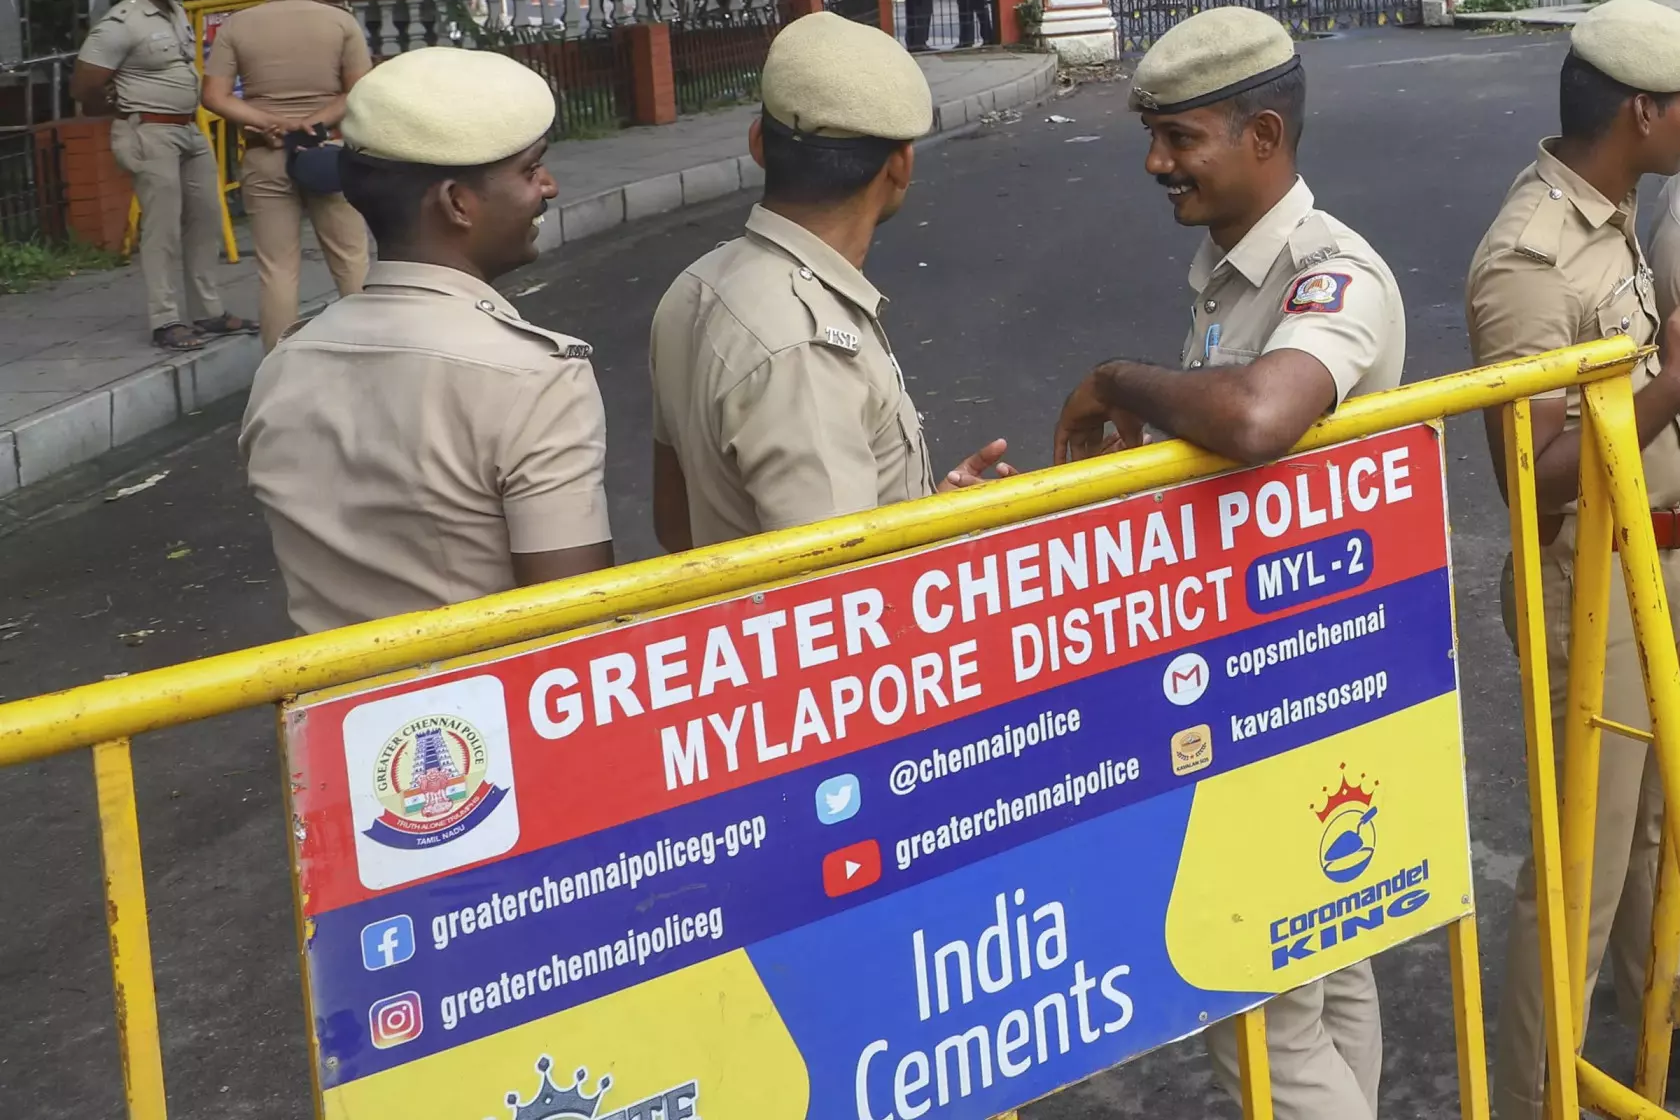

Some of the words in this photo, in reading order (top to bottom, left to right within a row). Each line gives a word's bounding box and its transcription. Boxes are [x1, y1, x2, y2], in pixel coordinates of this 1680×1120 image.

[825, 326, 859, 351] TSP
[527, 586, 891, 741] GREATER
[911, 502, 1199, 635] CHENNAI
[1217, 446, 1413, 548] POLICE
[659, 640, 982, 792] MYLAPORE
[1011, 566, 1233, 683] DISTRICT
[1256, 559, 1325, 601] MYL
[1347, 537, 1365, 574] 2
[1230, 669, 1388, 743] kavalansosapp
[377, 736, 402, 791] GREATER
[402, 717, 461, 737] CHENNAI
[461, 725, 485, 765] POLICE
[889, 703, 1082, 796] @chennaipolice
[416, 835, 442, 846] TAMIL
[442, 824, 466, 839] NADU
[894, 754, 1141, 871] greaterchennaipolice
[431, 814, 767, 951] greaterchennaipoliceg-gcp
[1268, 858, 1429, 946] Coromandel
[1270, 887, 1431, 971] KING
[440, 906, 724, 1030] greaterchennaipoliceg
[912, 884, 1069, 1023] India
[855, 964, 1135, 1120] Cements
